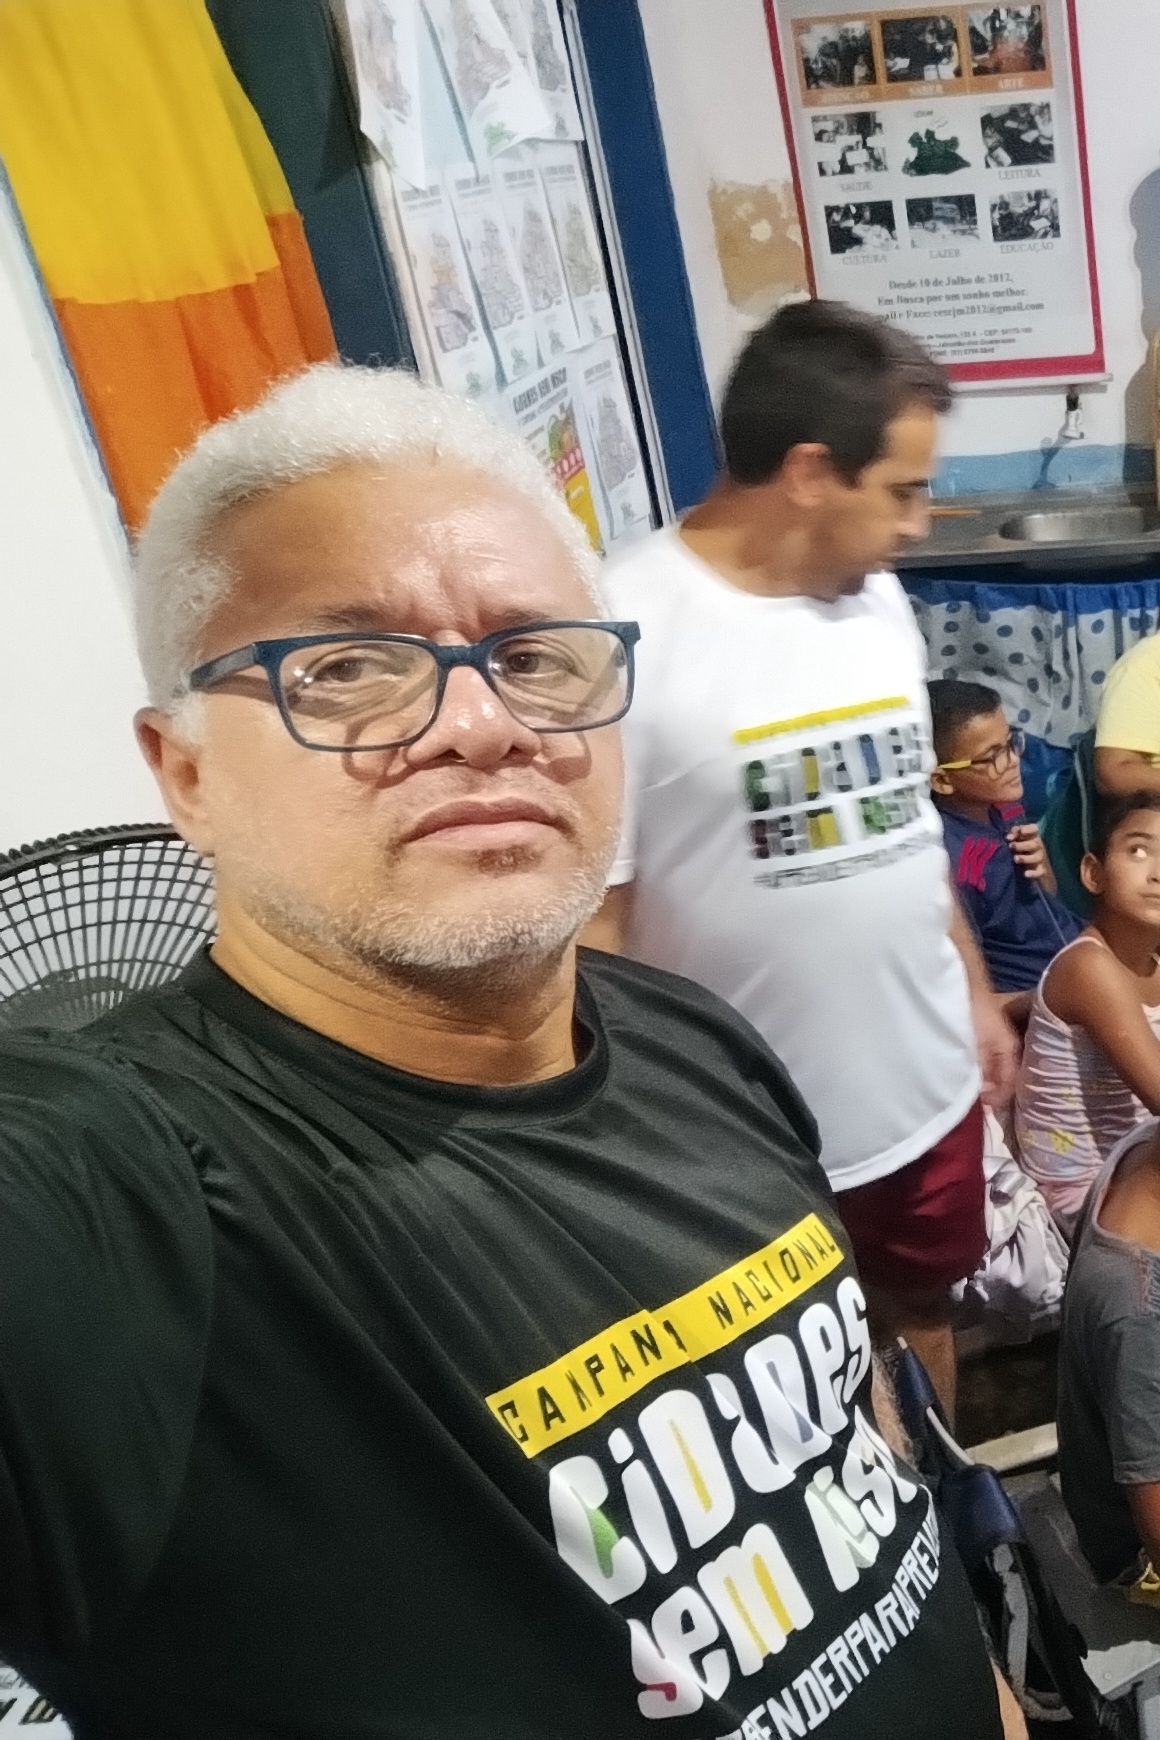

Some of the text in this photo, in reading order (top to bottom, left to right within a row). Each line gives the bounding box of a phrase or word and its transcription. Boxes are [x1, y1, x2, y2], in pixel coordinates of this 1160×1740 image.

[998, 168, 1042, 180] LEITURA
[1000, 241, 1054, 254] EDUCAÇÃO
[842, 253, 888, 266] CULTURA
[929, 249, 961, 260] LAZER
[889, 279, 917, 290] Desde
[920, 278, 931, 288] 10
[932, 277, 943, 287] de
[945, 275, 973, 286] Julho
[974, 274, 985, 284] de
[878, 296, 894, 306] Em
[926, 294, 942, 305] por
[944, 292, 960, 301] um
[962, 289, 990, 300] sonho
[708, 1223, 837, 1330] NACIONAL
